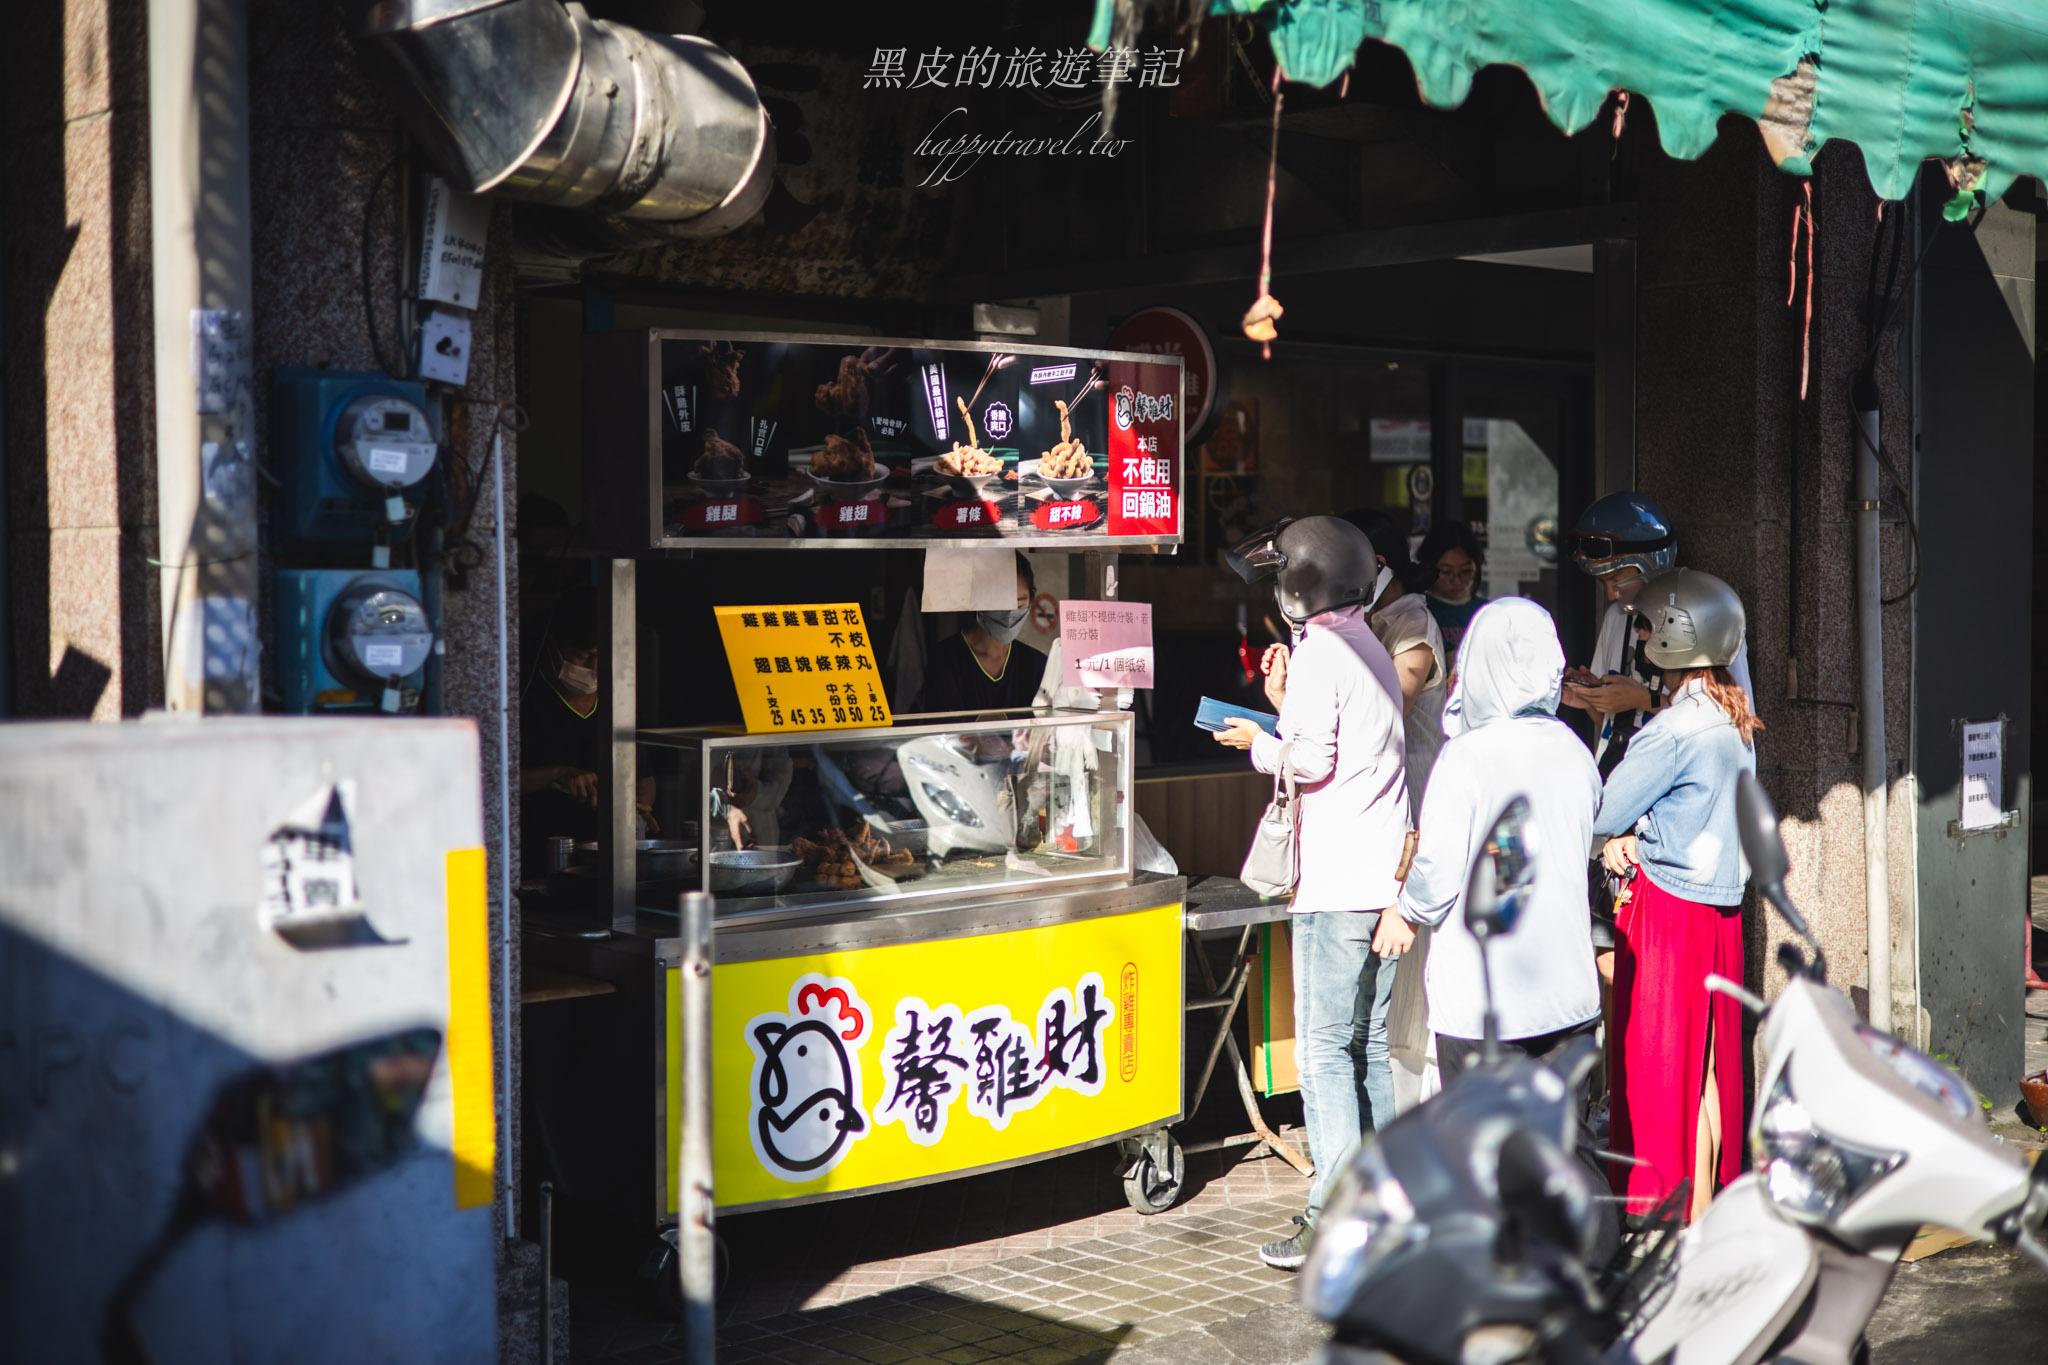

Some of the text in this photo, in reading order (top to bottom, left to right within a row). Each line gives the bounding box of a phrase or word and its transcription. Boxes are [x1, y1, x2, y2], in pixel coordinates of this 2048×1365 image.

[1137, 436, 1158, 452] 本店
[1122, 458, 1171, 485] 不使用
[704, 504, 738, 522] 雞腿
[839, 505, 869, 522] 雞翅
[1049, 505, 1083, 523] 甜不辣
[1122, 491, 1171, 519] 回鍋油
[955, 506, 981, 523] 薯條
[1066, 628, 1099, 641] 需分裝
[770, 705, 885, 726] 25 45 35 30 50 25
